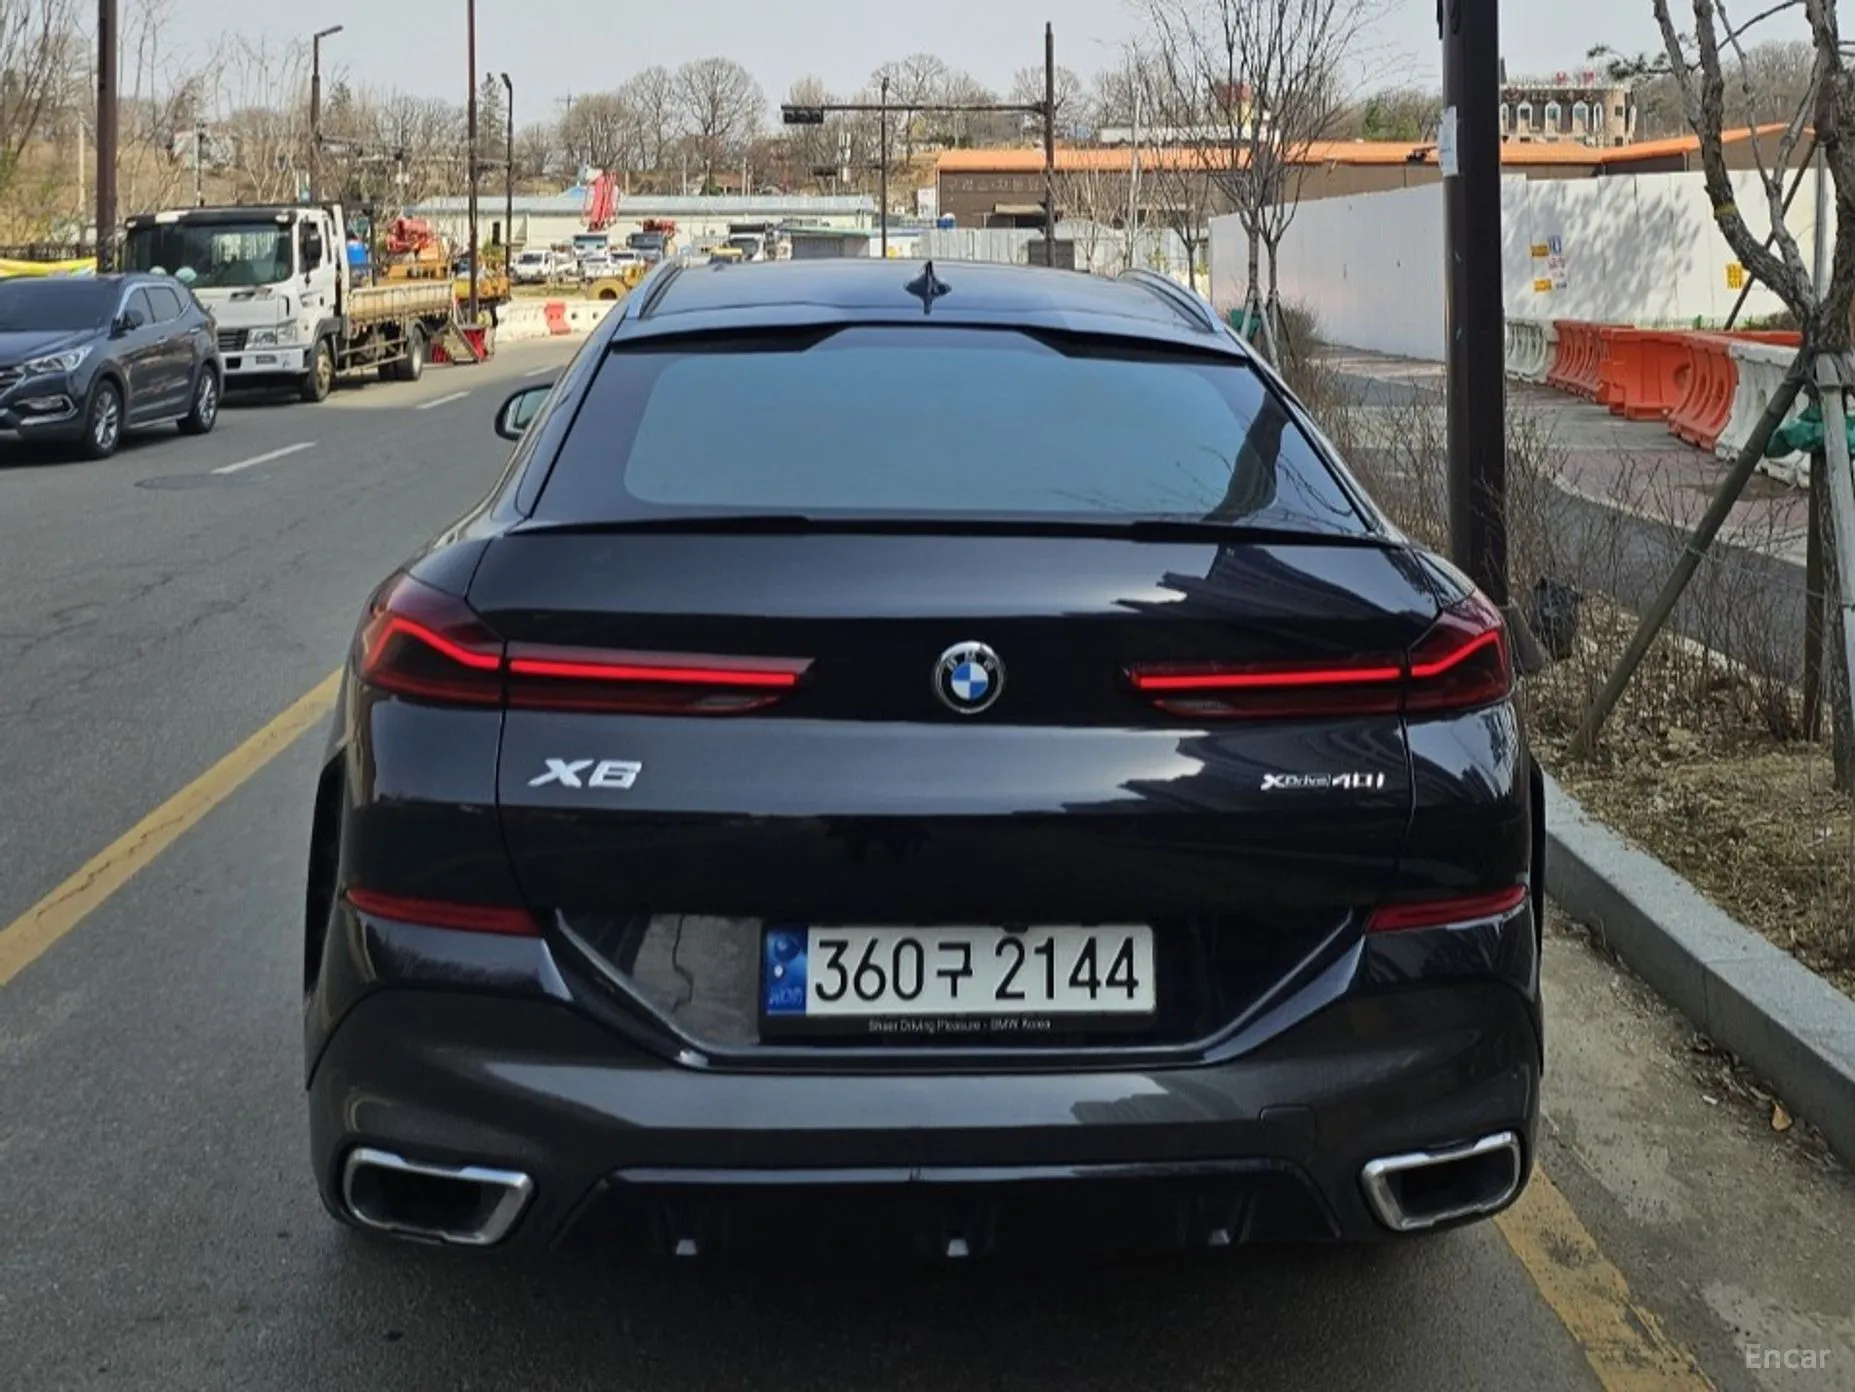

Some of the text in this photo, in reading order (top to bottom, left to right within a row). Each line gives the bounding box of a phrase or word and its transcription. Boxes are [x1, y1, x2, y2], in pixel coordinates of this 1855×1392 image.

[527, 758, 643, 790] X6
[814, 936, 1140, 1001] 360구 2144
[990, 1017, 1018, 1031] BMW
